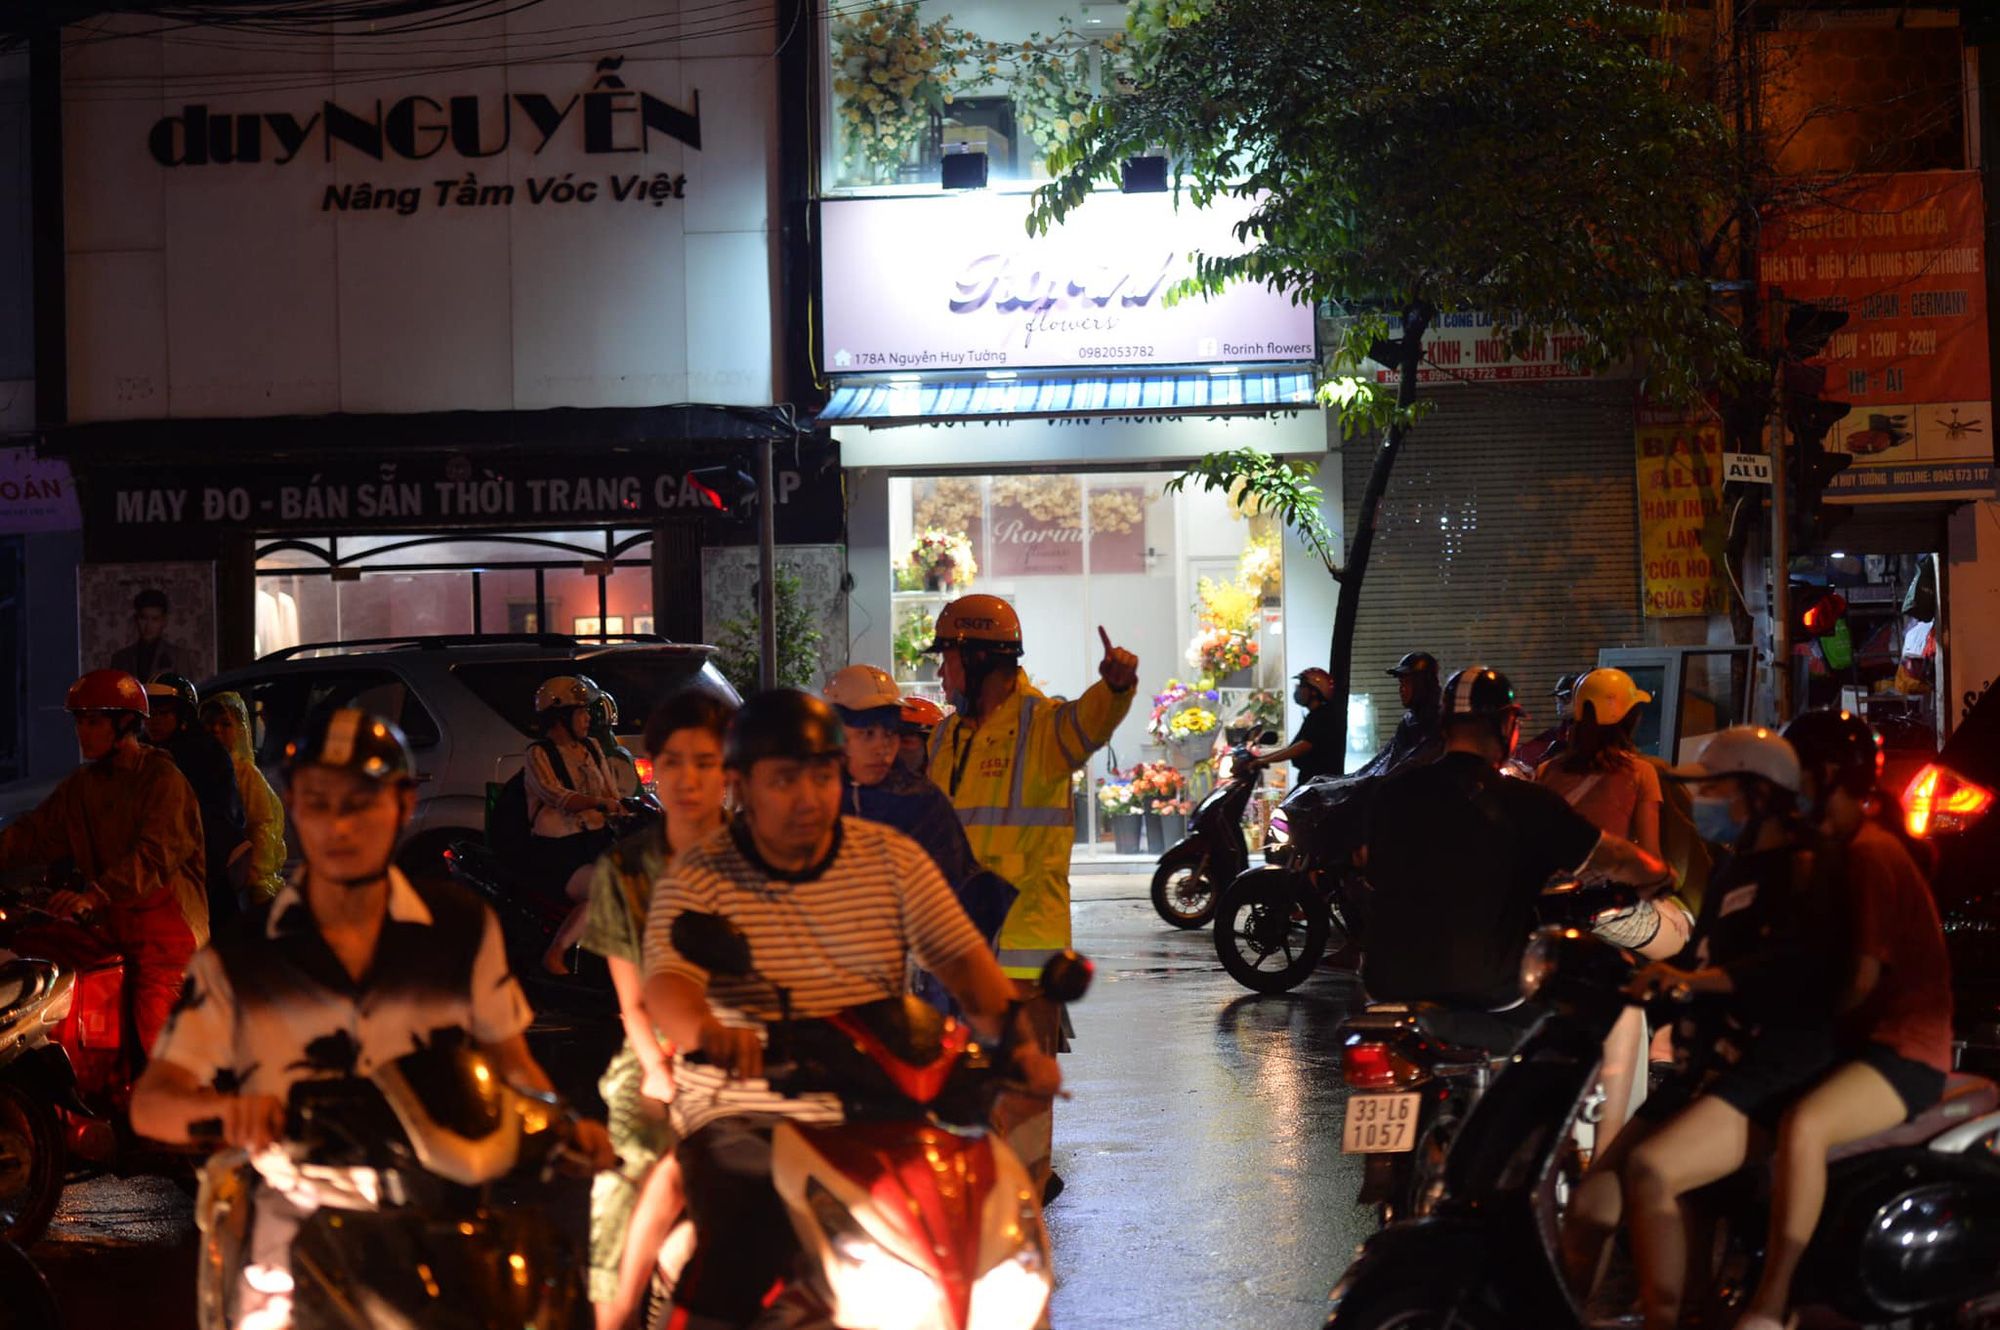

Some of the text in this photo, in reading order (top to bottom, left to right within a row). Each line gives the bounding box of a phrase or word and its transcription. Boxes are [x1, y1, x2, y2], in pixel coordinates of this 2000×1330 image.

[322, 172, 686, 214] Nâng Tầm Vóc Việt
[1847, 252, 1867, 279] GIA
[1904, 247, 1980, 276] SMARTHOME
[1862, 293, 1900, 319] JAPAN
[1910, 289, 1969, 318] GERMANY
[1025, 308, 1120, 349] flowers
[1078, 346, 1155, 358] 0982053782
[1223, 341, 1312, 355] Rorinh flowers
[1829, 332, 1858, 358] 100V
[1869, 331, 1898, 358] 120V
[1908, 329, 1937, 356] 220V
[855, 353, 885, 365] 178A
[940, 351, 964, 365] Huy
[1479, 367, 1497, 379] 722
[1511, 366, 1537, 378] 0912
[1848, 366, 1904, 394] IH AI
[1650, 467, 1714, 489] ALU
[1730, 464, 1768, 479] ALU
[116, 489, 188, 523] MAY
[203, 487, 250, 521] ĐO
[280, 473, 349, 520] BÁN
[356, 461, 422, 517] SẴN
[434, 467, 515, 515] THỜI
[526, 475, 641, 513] TRANG
[1645, 497, 1720, 519] HÀN INOX
[1649, 554, 1681, 579] CỬA
[1654, 584, 1687, 610] CỬA
[953, 617, 994, 630] CSGT
[1355, 1097, 1409, 1121] 33-L6
[1354, 1123, 1406, 1148] 1057
